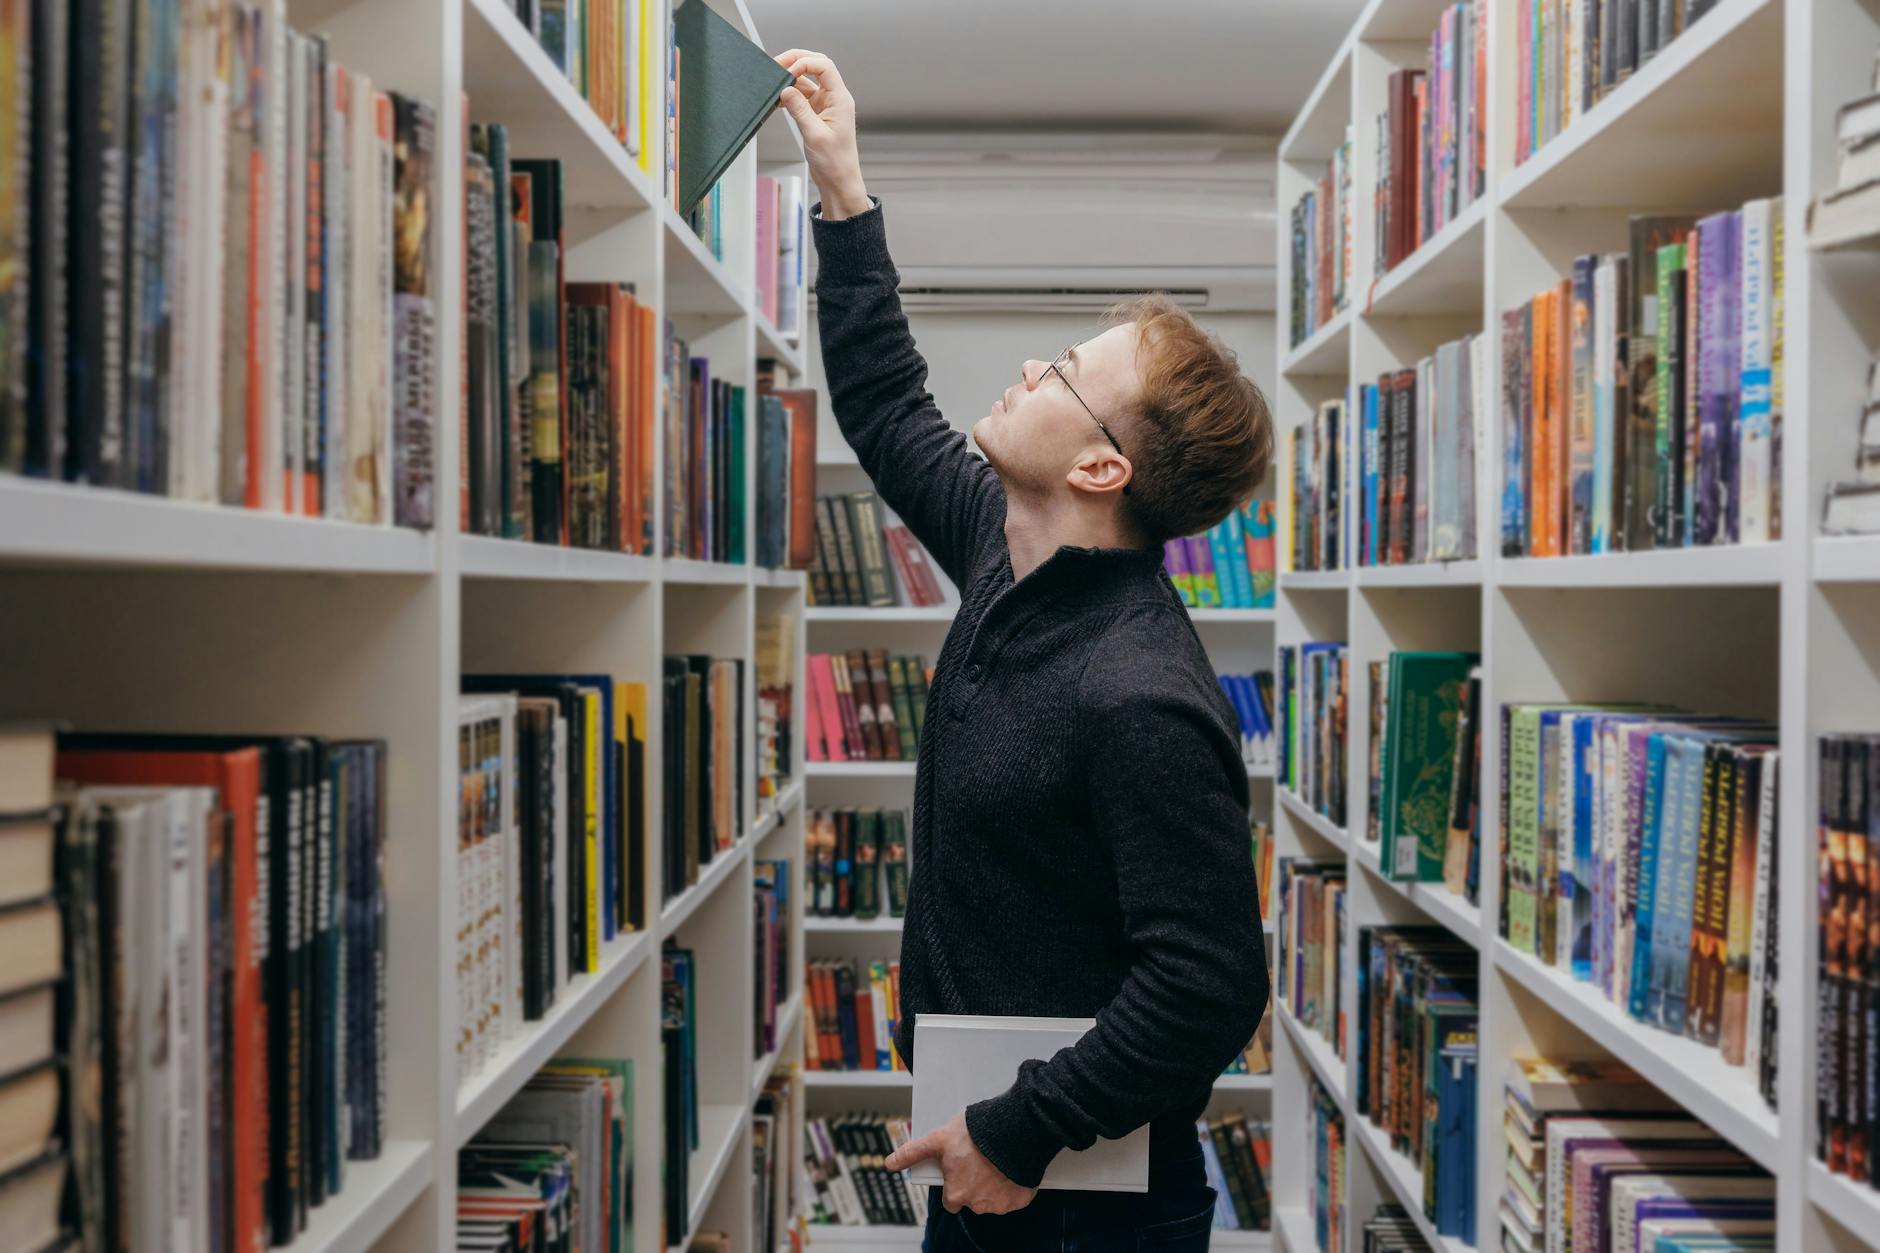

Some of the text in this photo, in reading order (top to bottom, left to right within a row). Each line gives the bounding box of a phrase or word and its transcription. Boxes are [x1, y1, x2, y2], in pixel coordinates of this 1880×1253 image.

[1657, 368, 1669, 430] НОРА
[1638, 752, 1656, 911] НОРА РОБЕРТС
[1694, 759, 1714, 924] НОРА РОБЕРТС
[1710, 761, 1733, 930] НОРА РОБЕРТС
